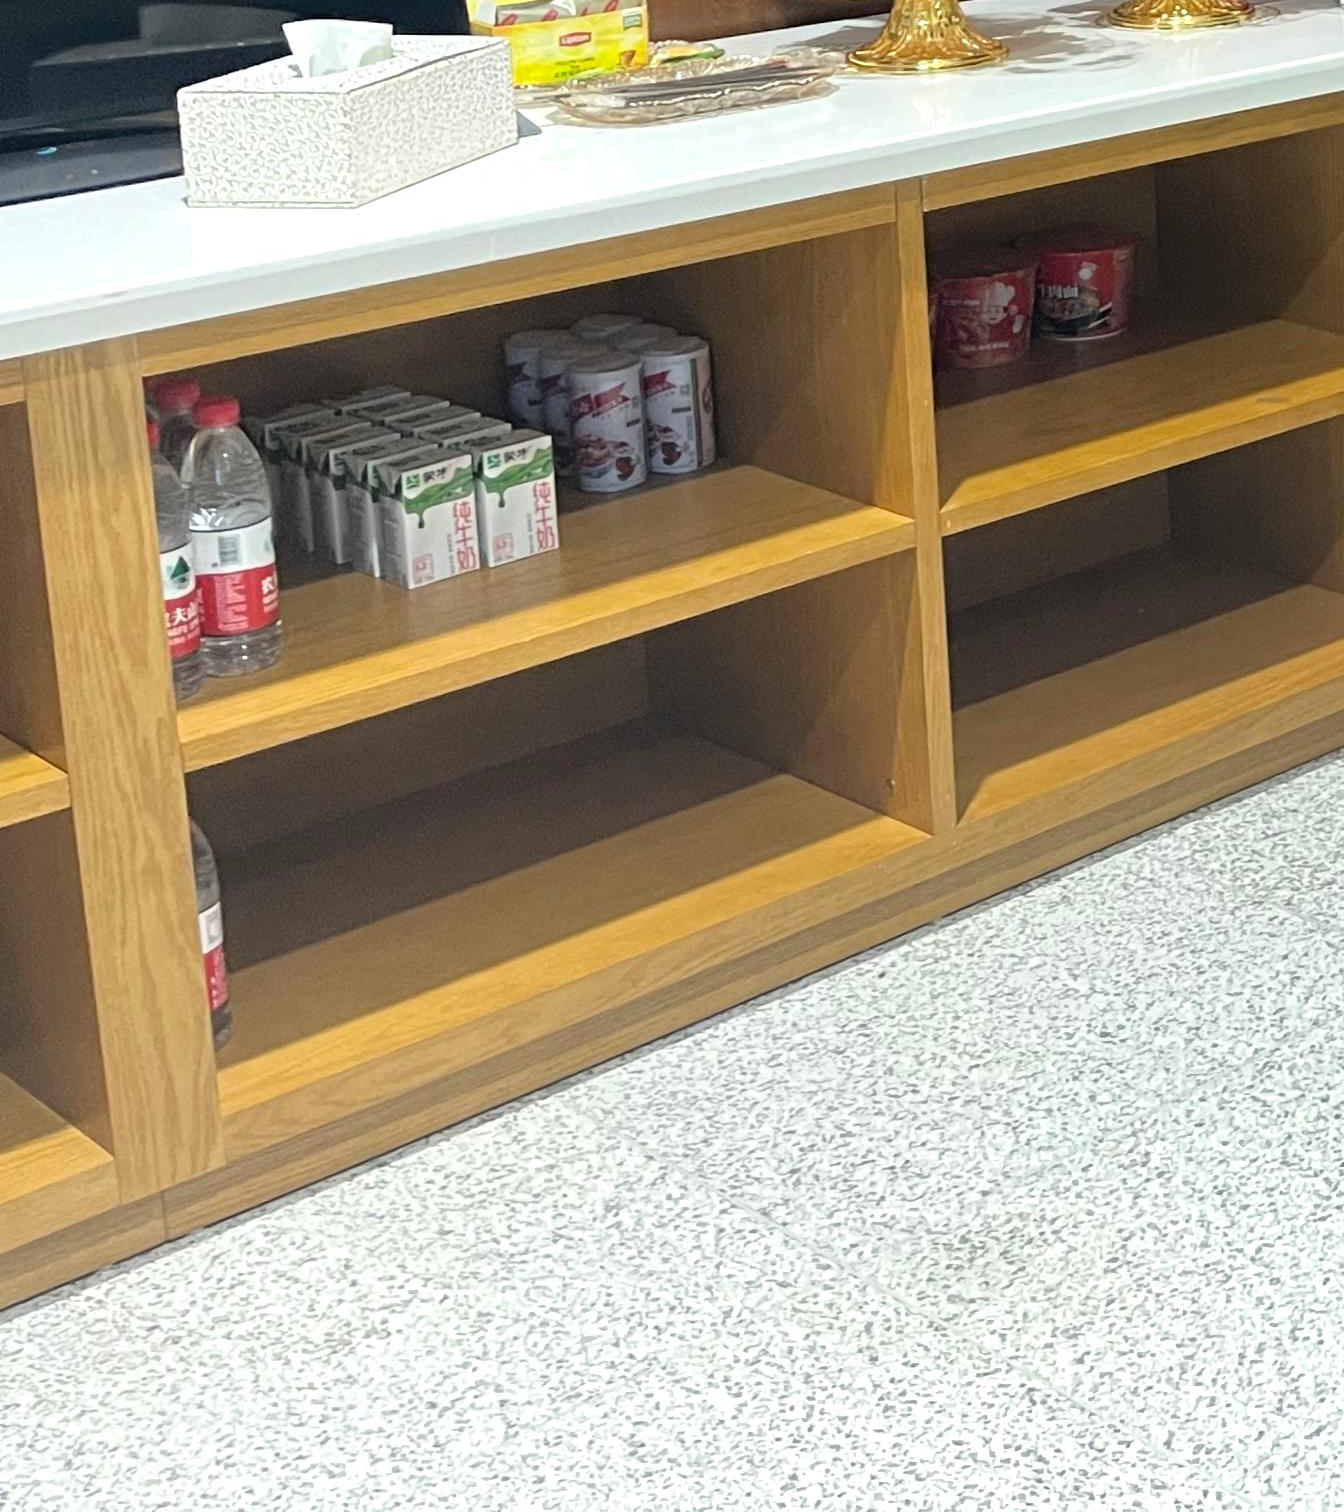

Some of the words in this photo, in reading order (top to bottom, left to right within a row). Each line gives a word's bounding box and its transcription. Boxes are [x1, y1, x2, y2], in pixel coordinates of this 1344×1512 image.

[453, 501, 477, 570] 纯牛奶
[533, 481, 555, 550] 纯牛奶
